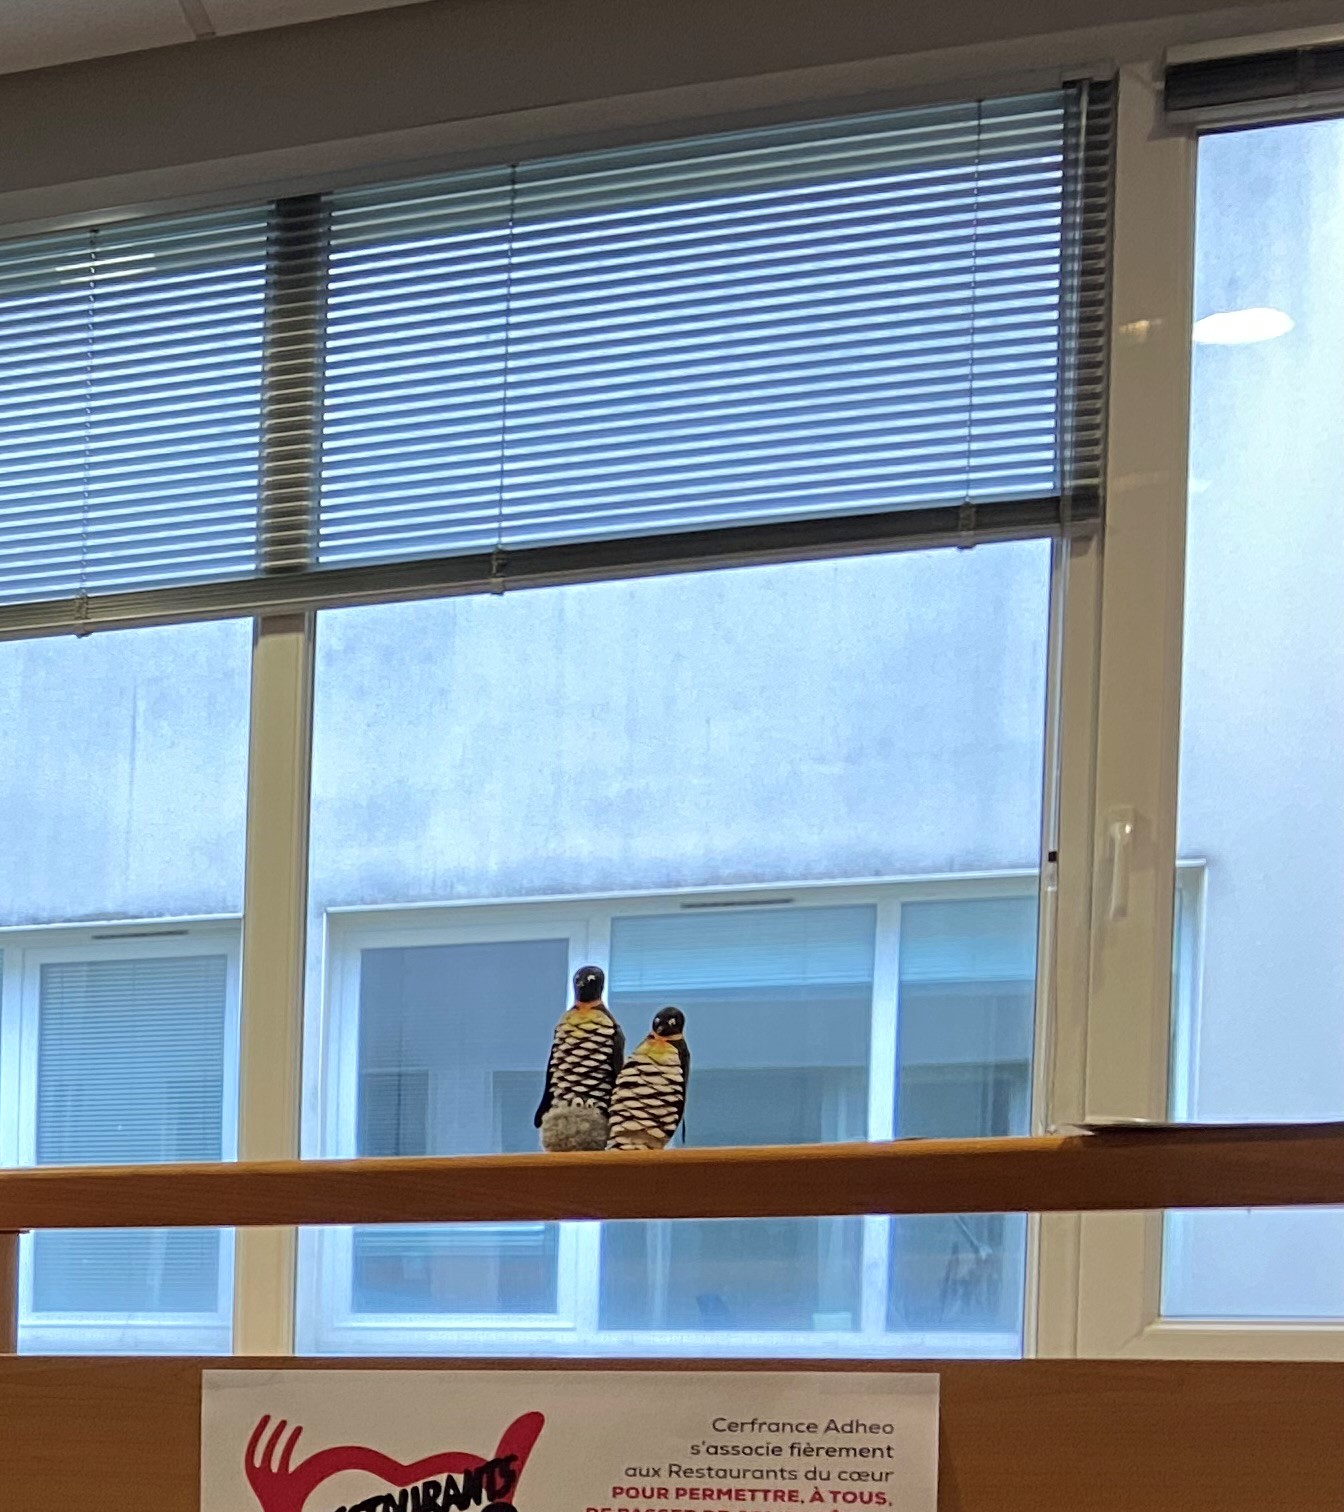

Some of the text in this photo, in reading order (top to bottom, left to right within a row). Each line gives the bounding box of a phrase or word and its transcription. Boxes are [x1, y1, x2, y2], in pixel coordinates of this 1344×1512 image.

[711, 1417, 895, 1435] Cerfrance Adheo
[690, 1440, 895, 1459] s'associe fièrement
[624, 1465, 661, 1479] aux
[667, 1463, 798, 1481] Restaurants
[804, 1465, 831, 1482] du
[611, 1485, 669, 1501] POUR
[809, 1485, 825, 1504] À
